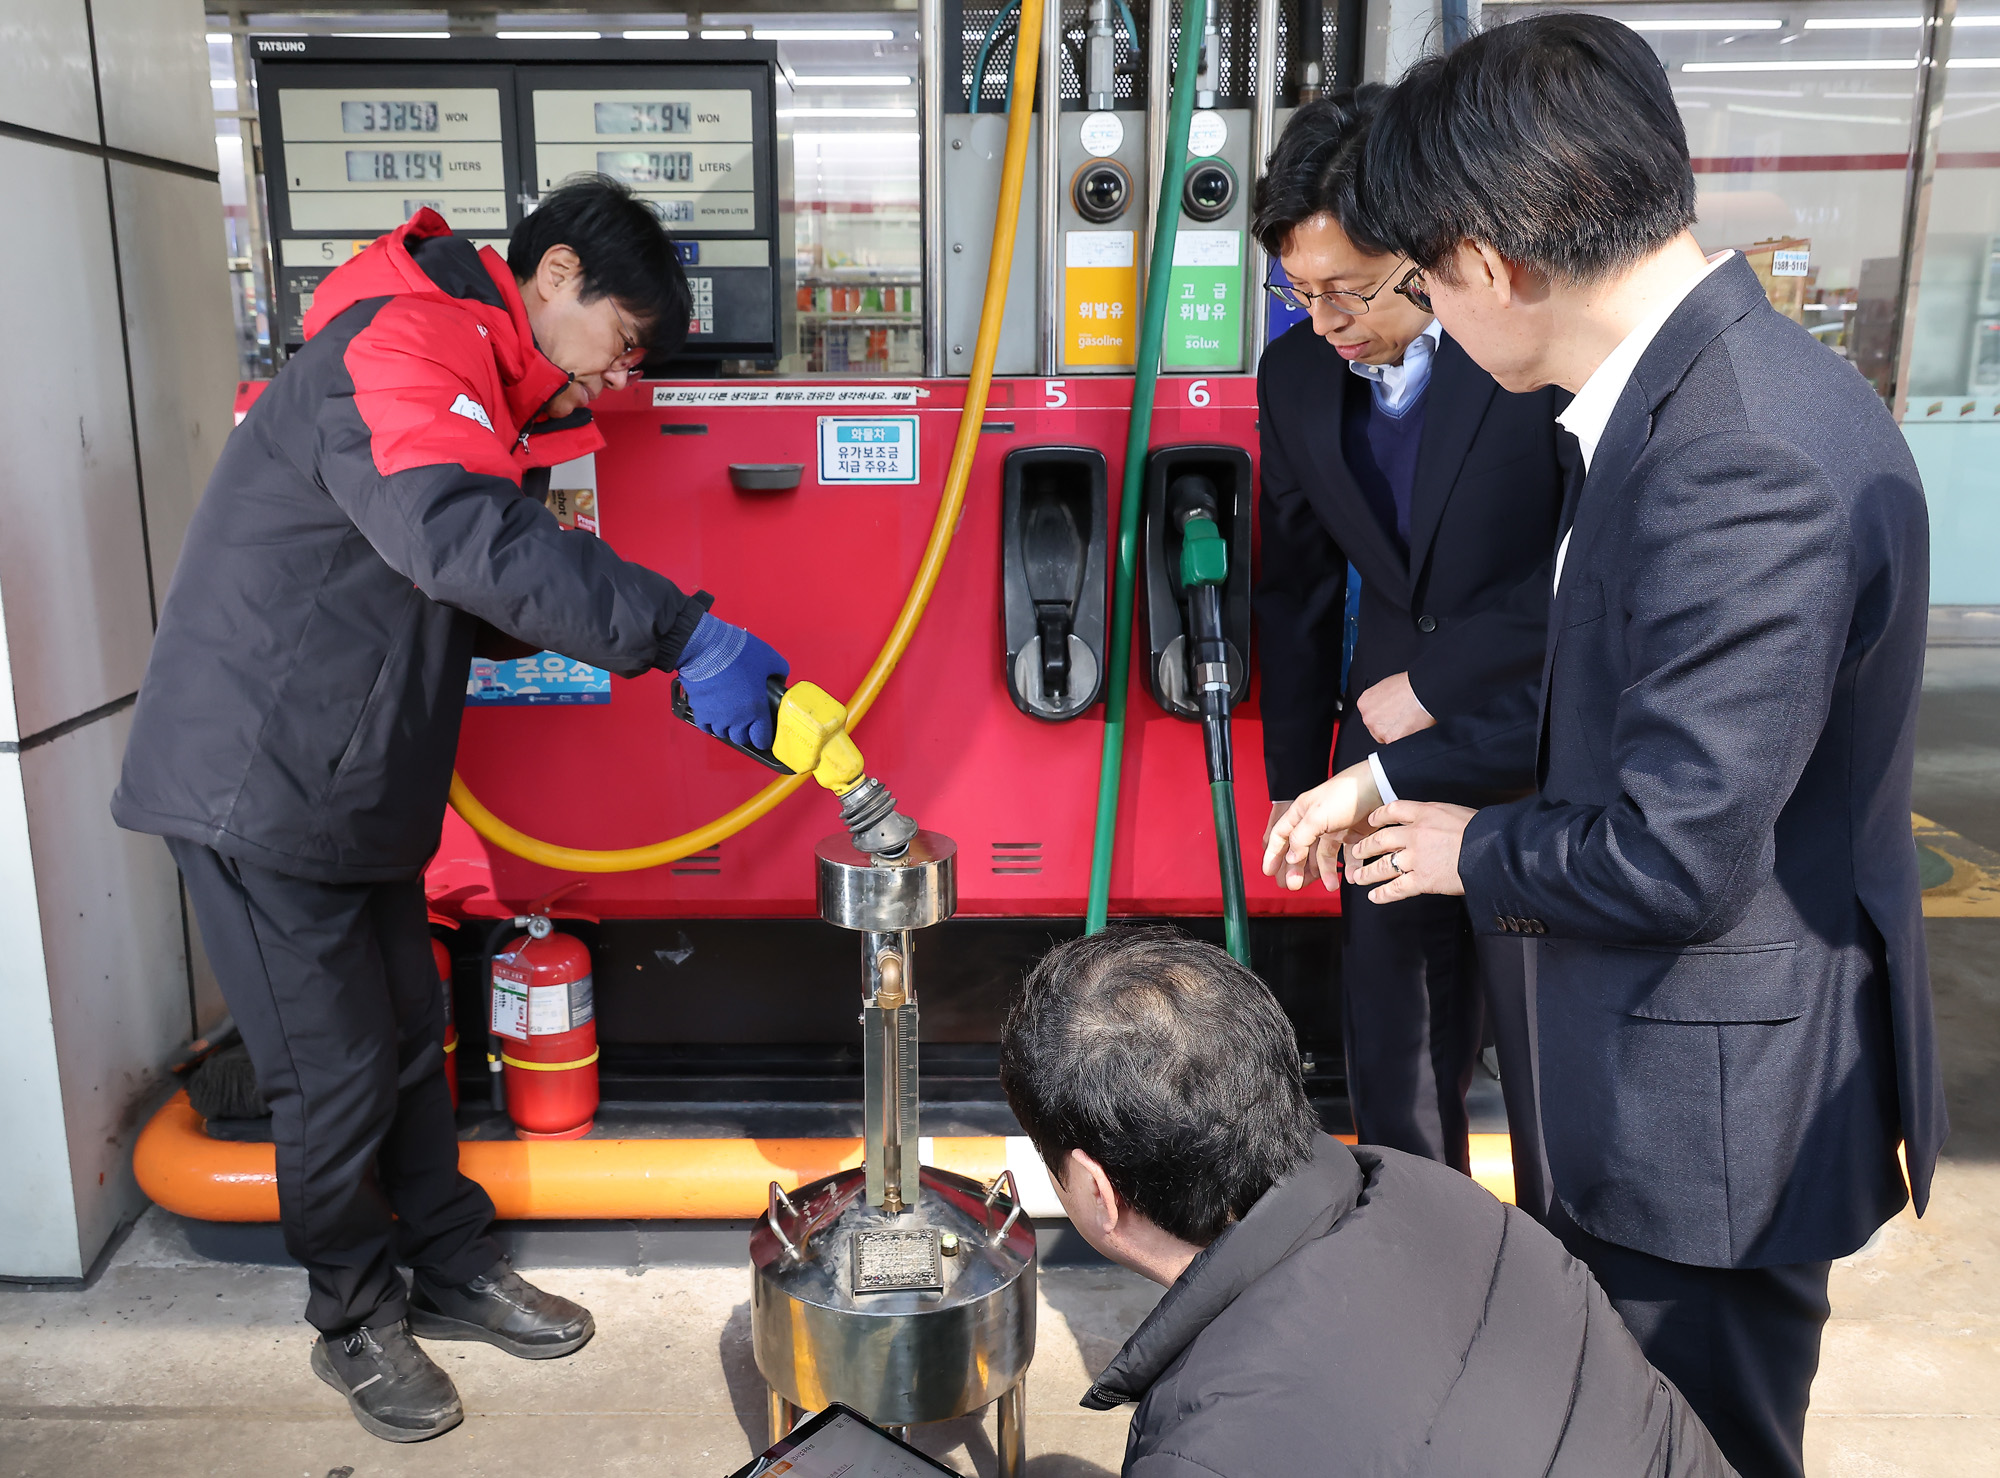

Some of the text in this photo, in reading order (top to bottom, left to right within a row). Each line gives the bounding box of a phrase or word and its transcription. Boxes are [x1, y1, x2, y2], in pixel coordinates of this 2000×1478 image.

[257, 41, 306, 52] TATSUNO
[445, 113, 469, 122] WON
[697, 114, 720, 123] WON
[449, 162, 482, 171] LITERS
[699, 163, 732, 172] LITERS
[321, 242, 334, 260] 5
[1079, 302, 1124, 319] 휘발유
[1180, 303, 1227, 320] 휘발유
[703, 322, 709, 330] L
[1078, 335, 1123, 349] gasoline
[1185, 336, 1219, 349] solux
[677, 392, 706, 403] 진입시
[708, 392, 728, 401] 다른
[731, 392, 768, 401] 생각말고
[891, 391, 911, 401] 제발
[1045, 380, 1068, 408] 5
[1187, 380, 1211, 408] 6
[838, 446, 899, 459] 유가보조금
[838, 460, 899, 473] 지급 주유소
[515, 657, 595, 683] 주유소
